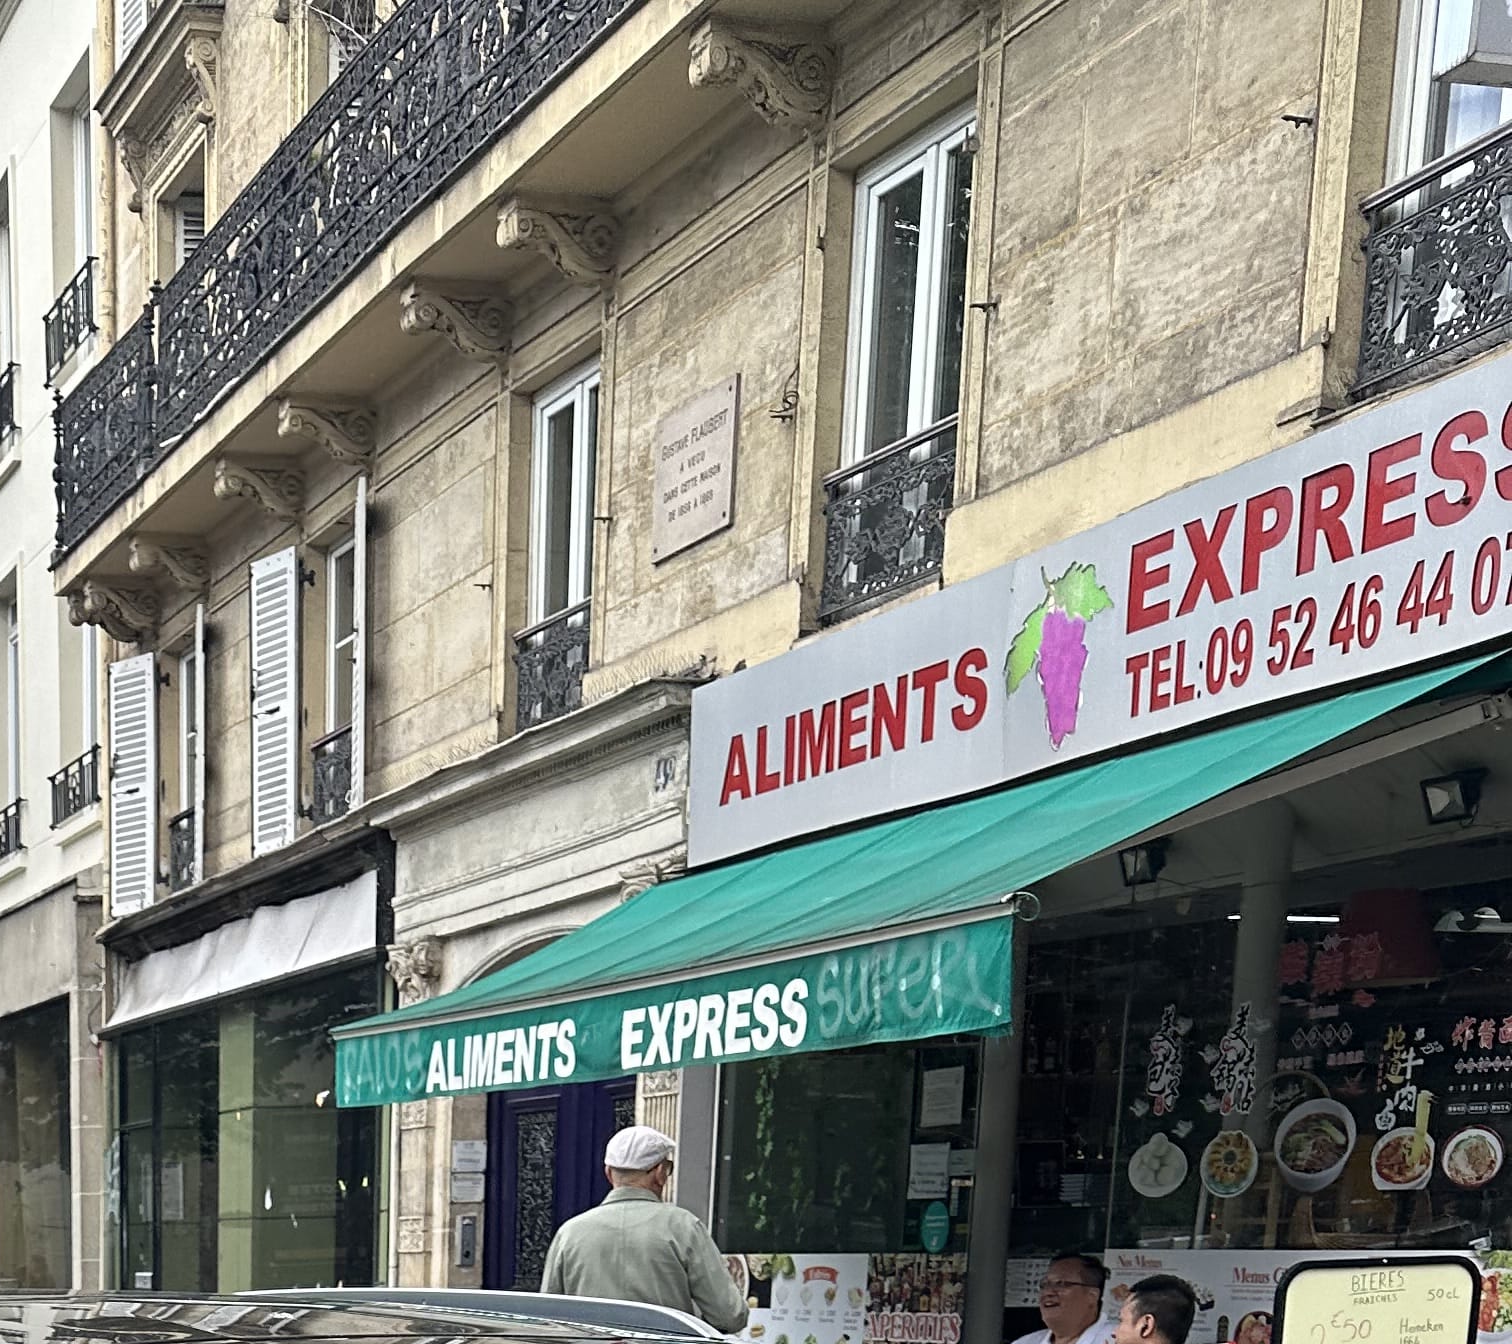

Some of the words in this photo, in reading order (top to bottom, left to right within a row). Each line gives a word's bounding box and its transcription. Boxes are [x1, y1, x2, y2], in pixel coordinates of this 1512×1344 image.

[691, 408, 728, 445] FLAUBERT
[1126, 400, 1512, 635] EXPRES
[1267, 604, 1315, 677] 52
[1330, 574, 1383, 655] 46
[1397, 550, 1455, 635] 44
[1471, 531, 1512, 616] 0
[719, 646, 989, 807] ALIMENTS
[425, 1018, 577, 1094] ALIMENTS
[620, 977, 809, 1070] EXPRESS
[867, 1312, 961, 1344] APERITIFS
[1351, 1270, 1405, 1292] BIERES
